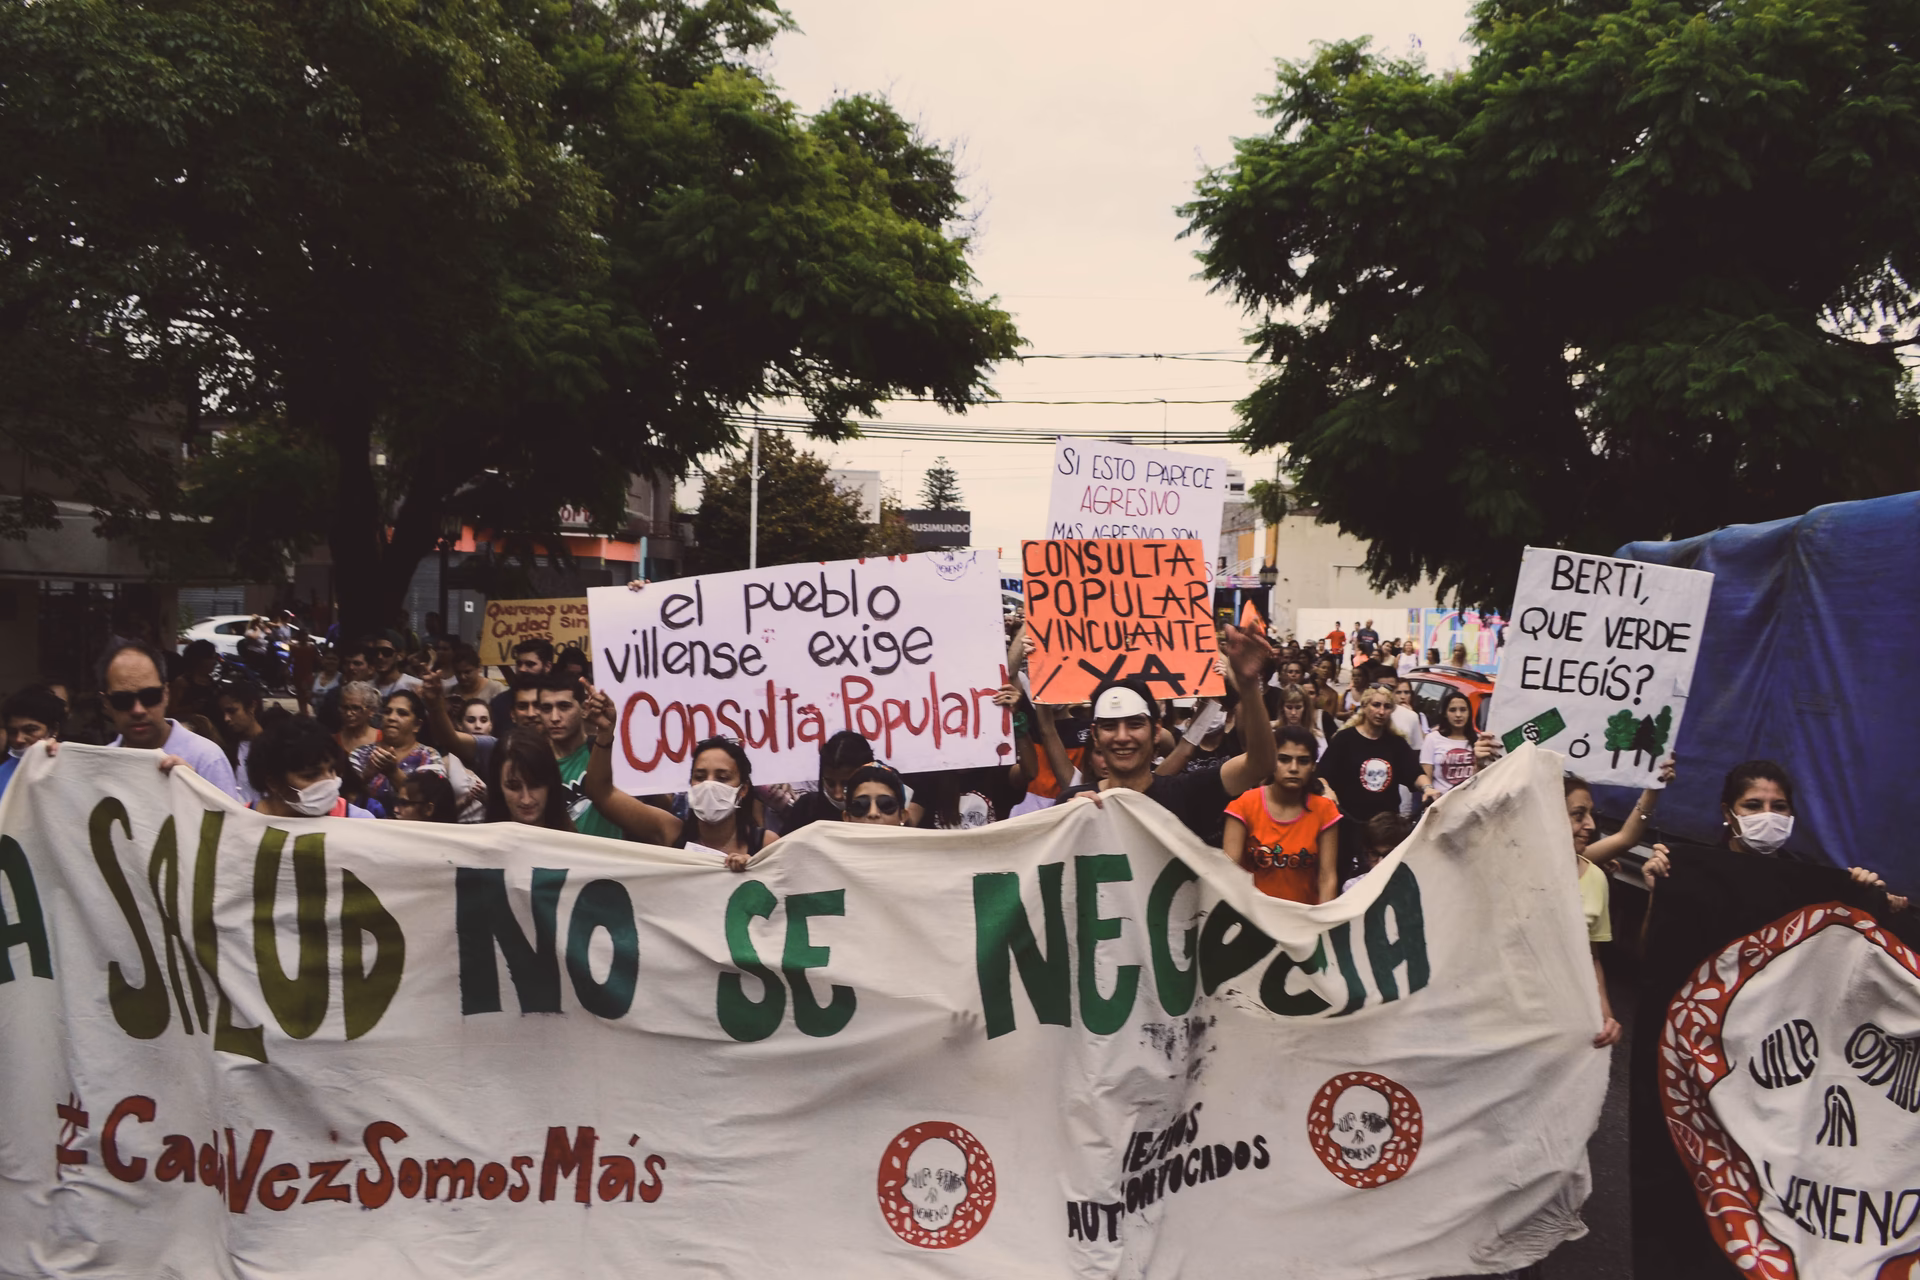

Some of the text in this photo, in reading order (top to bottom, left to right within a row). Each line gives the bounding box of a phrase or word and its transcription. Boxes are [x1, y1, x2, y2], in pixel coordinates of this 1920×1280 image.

[1058, 448, 1215, 489] SI ESTO PARECE
[1080, 485, 1180, 516] AGRESIVO
[1022, 541, 1195, 578] CONSULTA
[487, 602, 589, 621] Queremos una
[661, 569, 901, 634] el pueblo
[1026, 578, 1215, 620] POPULAR
[1026, 618, 1216, 653] VINCULANTE
[1520, 607, 1692, 653] QUE VERDE
[604, 623, 933, 684] villense exige
[620, 680, 826, 773] Consulta
[89, 796, 406, 1064] SALUD
[455, 866, 640, 1021] NO
[717, 879, 857, 1042] SE
[973, 853, 1430, 1041] NEGOCIA
[1763, 1160, 1920, 1247] VENENO
